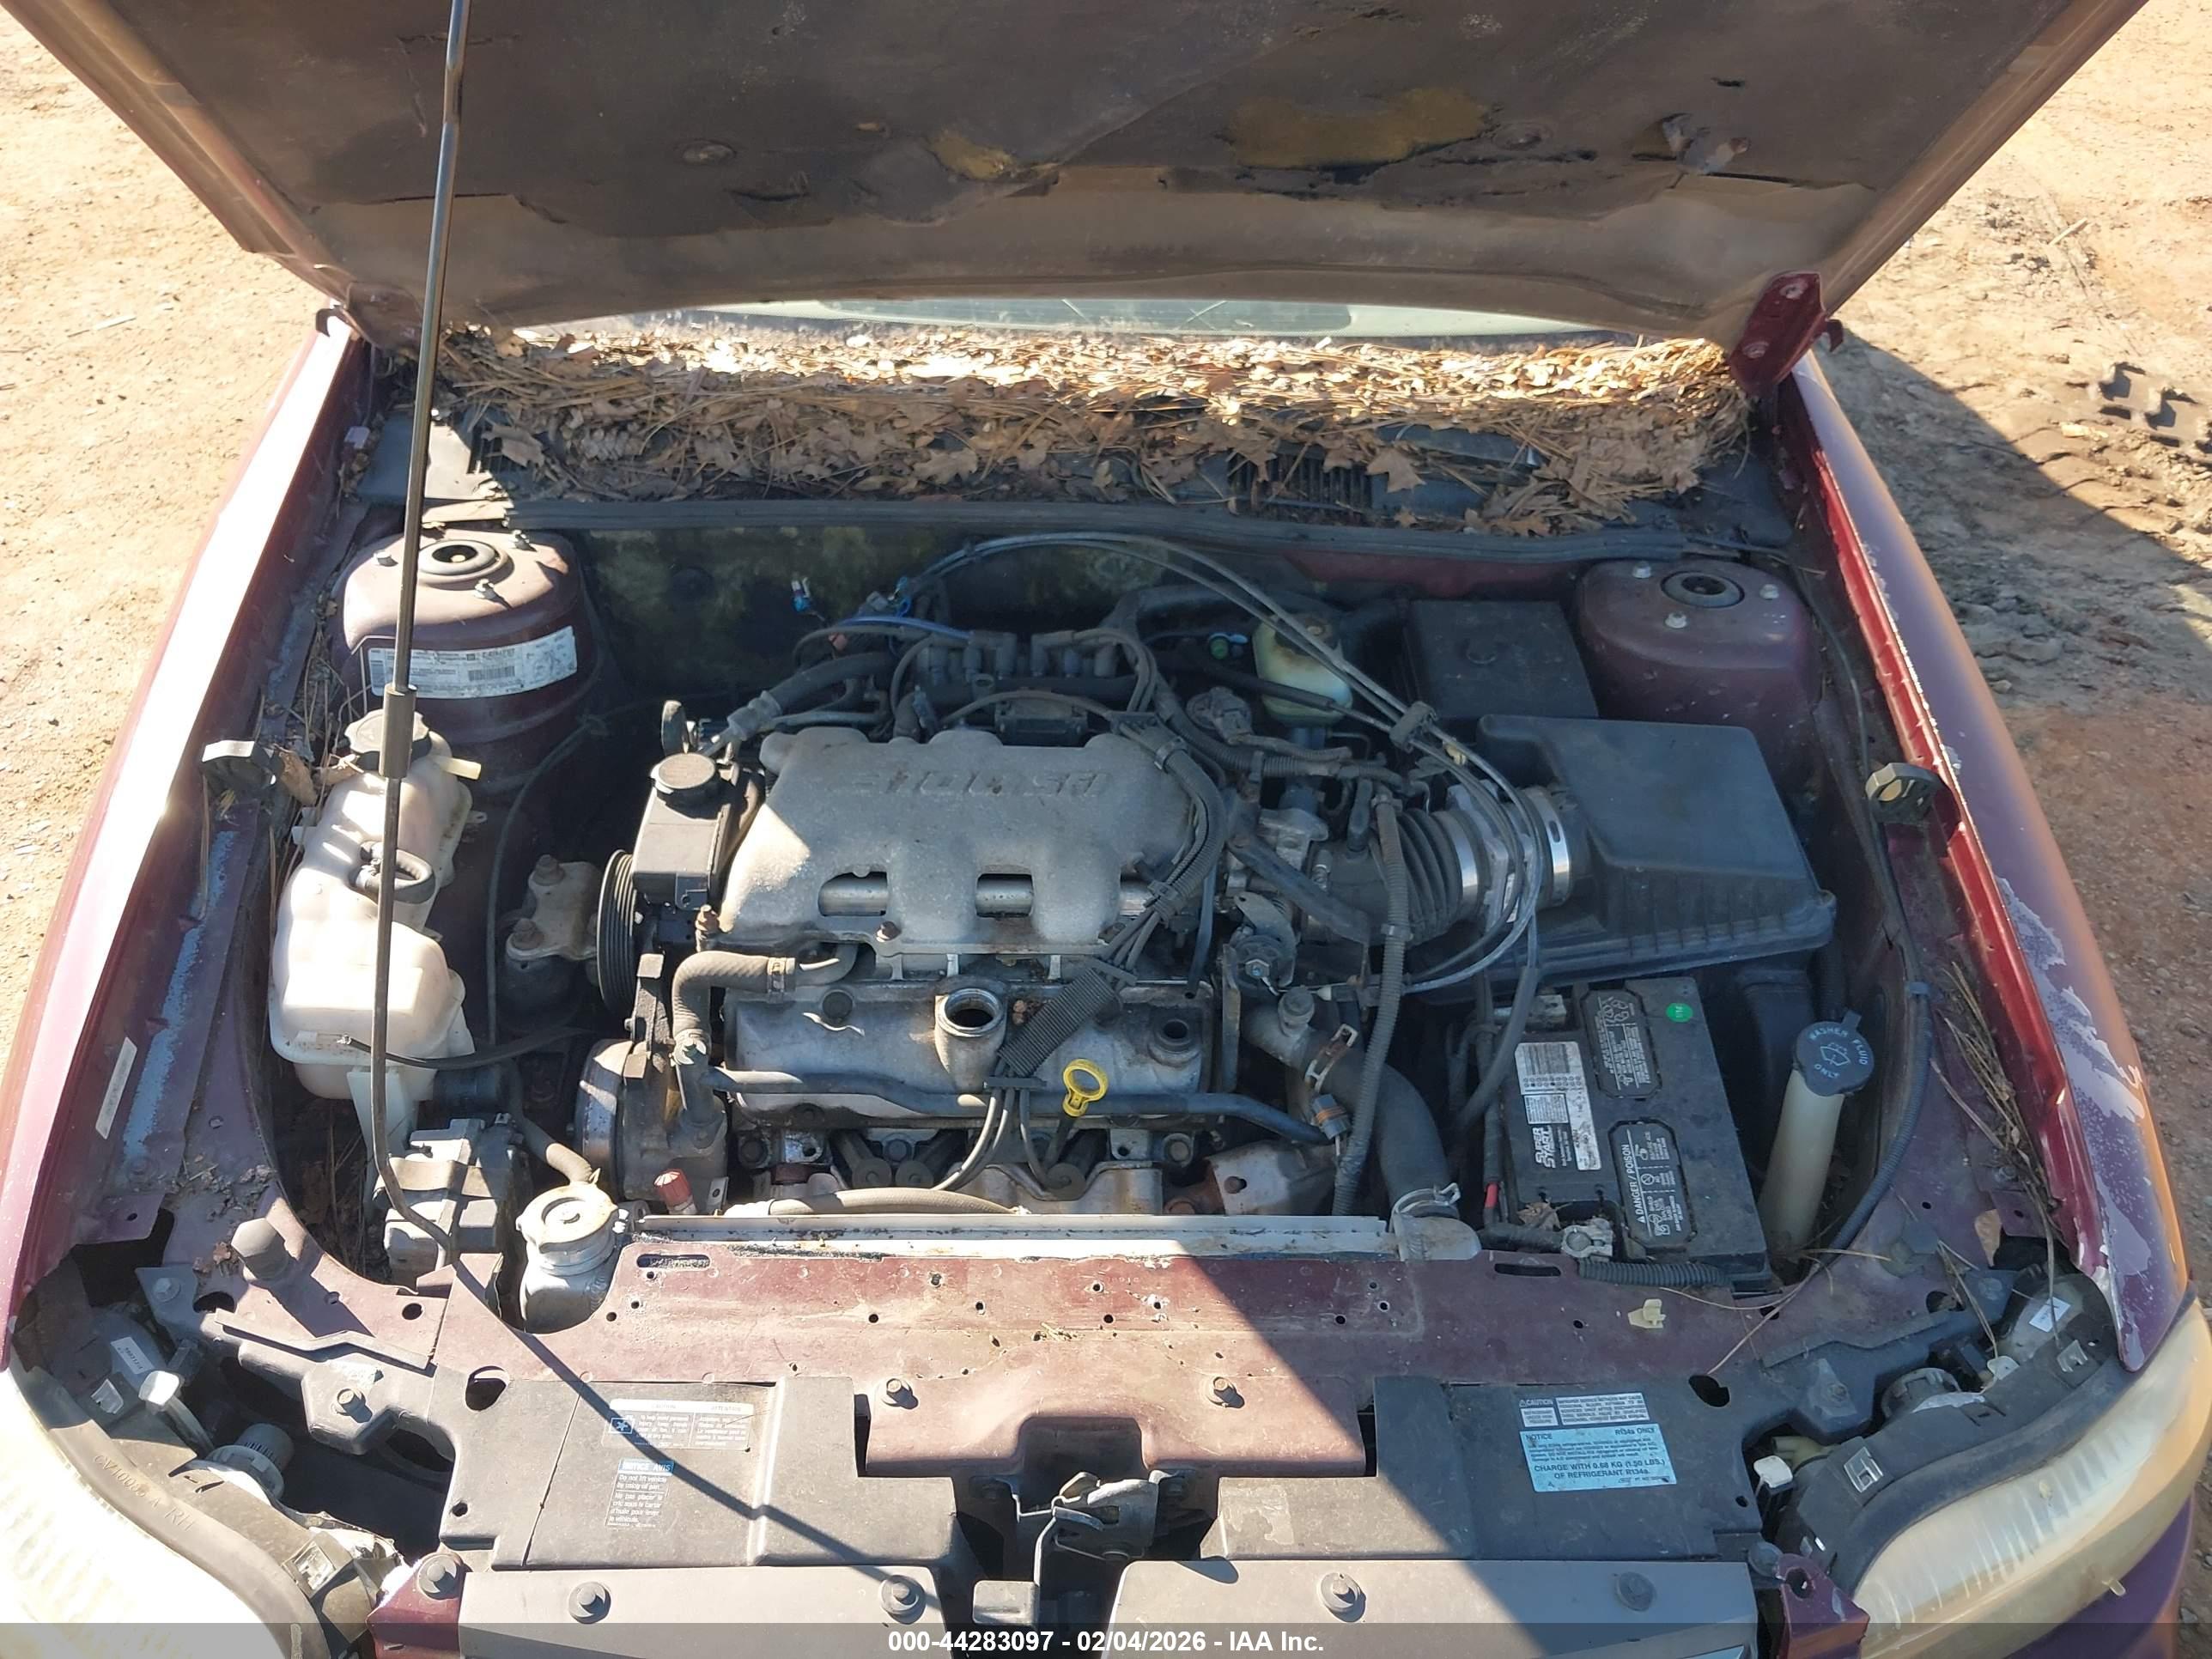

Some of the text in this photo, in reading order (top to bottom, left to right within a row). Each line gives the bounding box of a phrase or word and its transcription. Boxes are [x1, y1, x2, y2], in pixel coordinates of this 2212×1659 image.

[1533, 1127, 1544, 1164] SUPER
[1542, 1125, 1556, 1168] START
[1621, 1144, 1636, 1174] POISON
[1629, 1182, 1644, 1215] DANGER
[653, 1463, 672, 1472] AVIS
[1568, 1469, 1625, 1478] REFRIGERANT
